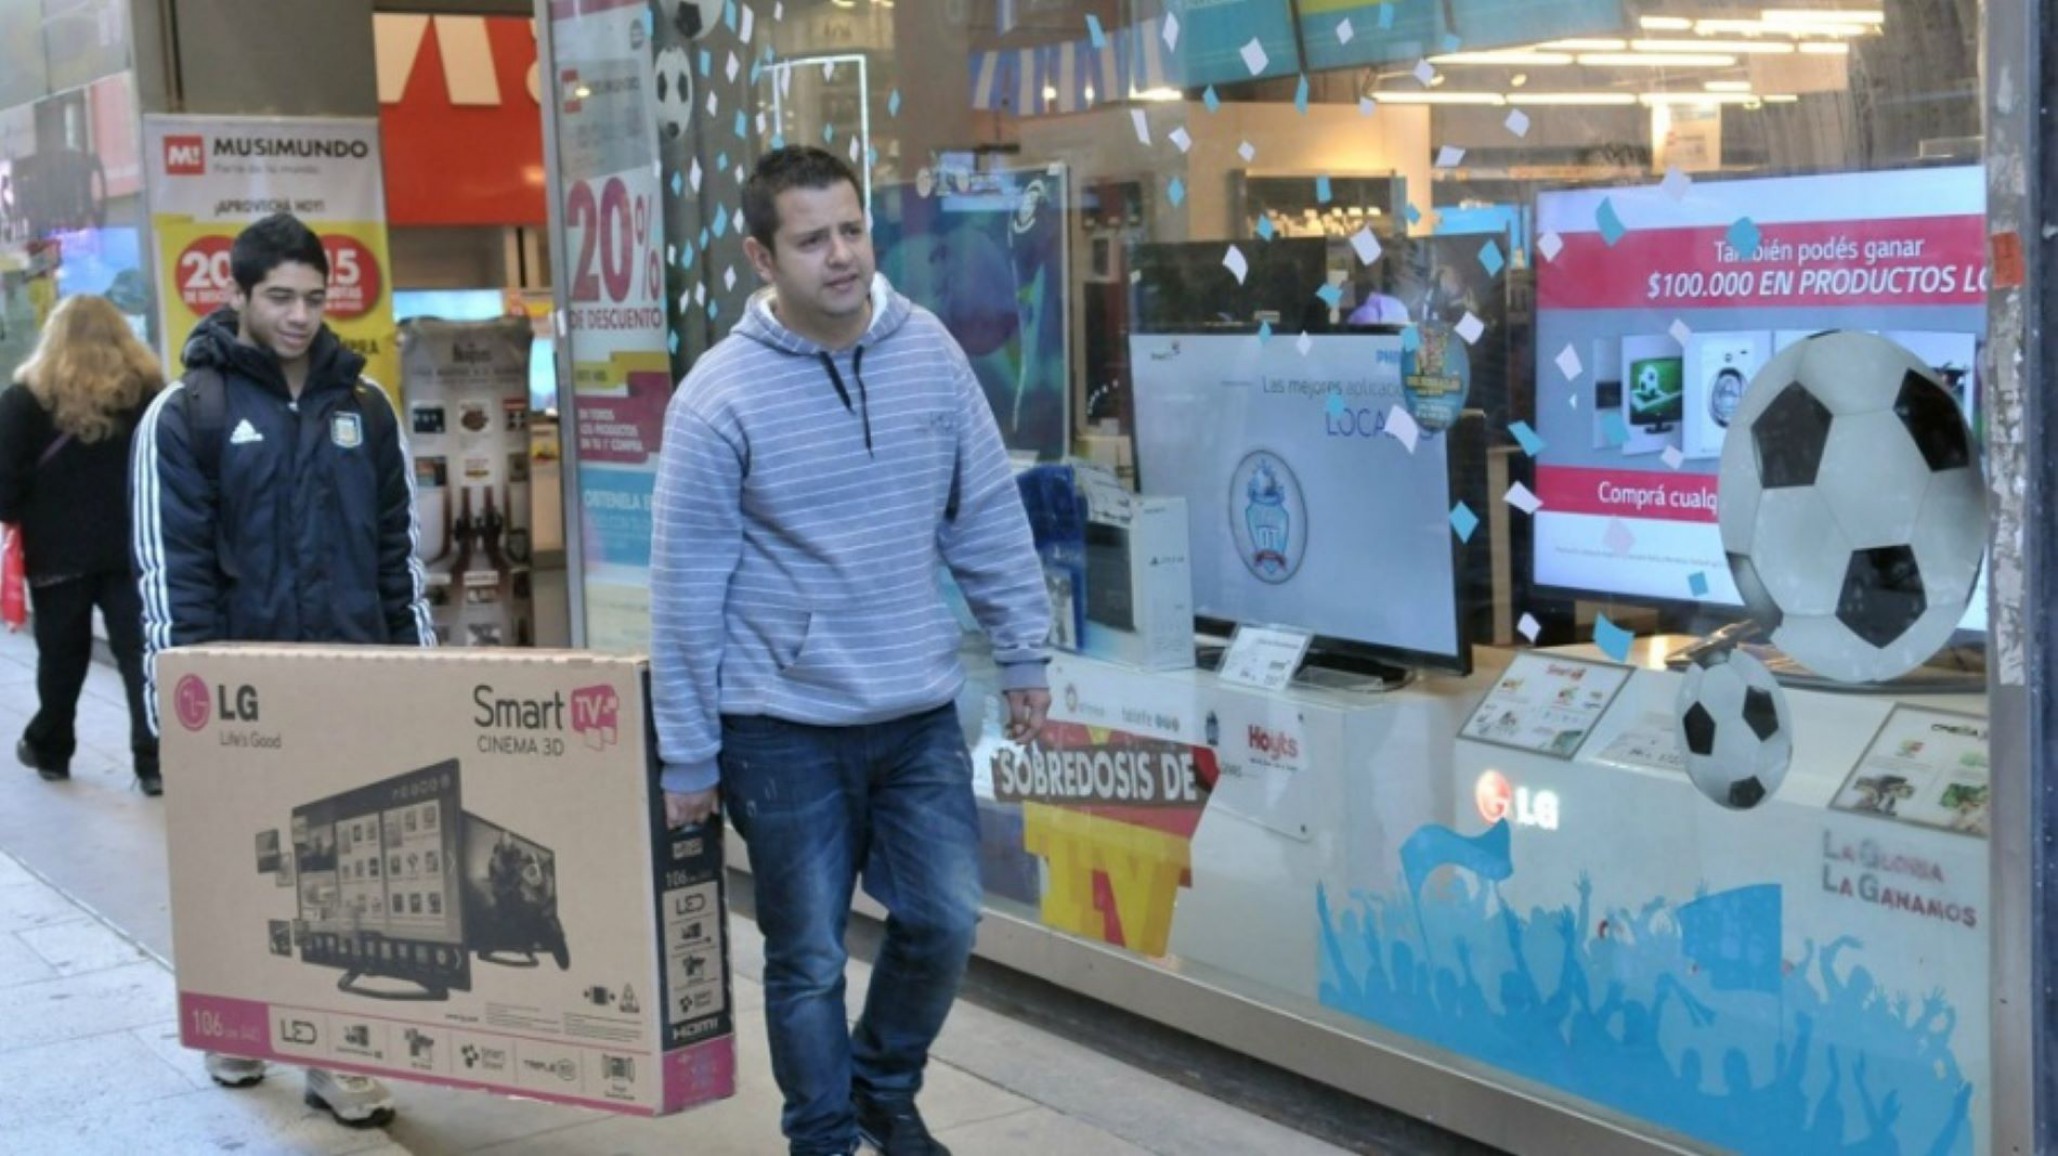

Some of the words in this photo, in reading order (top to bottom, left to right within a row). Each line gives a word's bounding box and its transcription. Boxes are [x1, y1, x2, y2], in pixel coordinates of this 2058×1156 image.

[213, 137, 369, 158] MUSIMUNDO
[1714, 238, 1794, 263] Tabién
[1798, 237, 1859, 267] podés
[1864, 238, 1924, 263] ganar
[1647, 271, 1754, 299] $100.000
[1759, 269, 1794, 296] EN
[1799, 266, 1956, 295] PRODUCTOS
[569, 311, 585, 329] DE
[588, 308, 662, 330] DESCUENTO
[1263, 374, 1286, 394] Las
[1598, 481, 1666, 511] Comprá
[1670, 487, 1718, 516] cualq
[218, 684, 259, 722] LG
[473, 684, 564, 730] Smart
[250, 731, 282, 749] Good
[477, 735, 538, 754] CINEMA
[542, 737, 564, 757] 3D
[1248, 723, 1298, 759] Hoyts
[1000, 750, 1155, 800] SOBREDOSIS
[1161, 752, 1197, 800] DE
[1517, 786, 1558, 831] LG
[1023, 800, 1193, 958] TV
[676, 893, 706, 915] LED
[1858, 873, 1977, 928] GANAMOS
[192, 1011, 223, 1036] 106
[280, 1019, 317, 1045] LED
